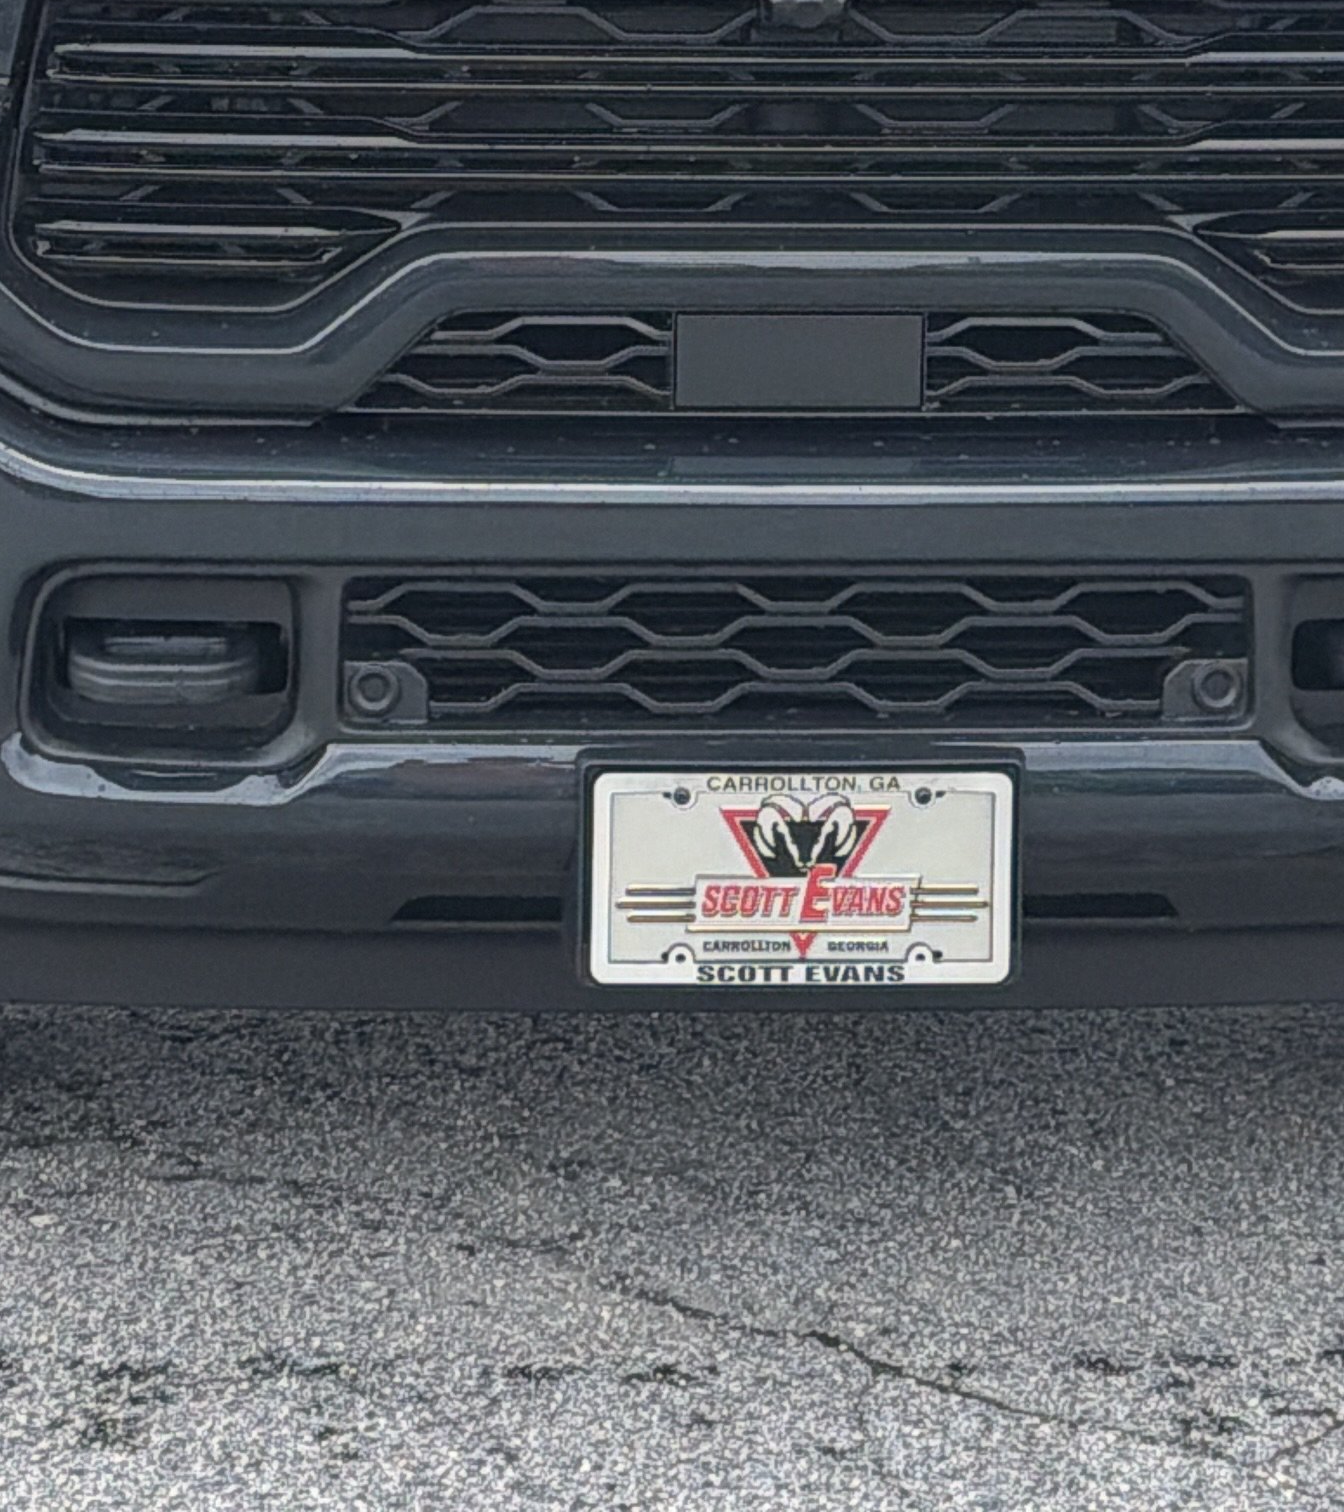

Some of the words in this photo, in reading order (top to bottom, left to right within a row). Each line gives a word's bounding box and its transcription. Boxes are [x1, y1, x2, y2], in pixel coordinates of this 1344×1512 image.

[869, 775, 901, 792] GA
[701, 884, 798, 918] SCOTT
[799, 863, 906, 923] EVANS
[702, 940, 791, 953] CARROLLTON
[827, 940, 889, 953] GEORGIA
[696, 964, 794, 983] SCOTT
[805, 964, 905, 983] EVANS
